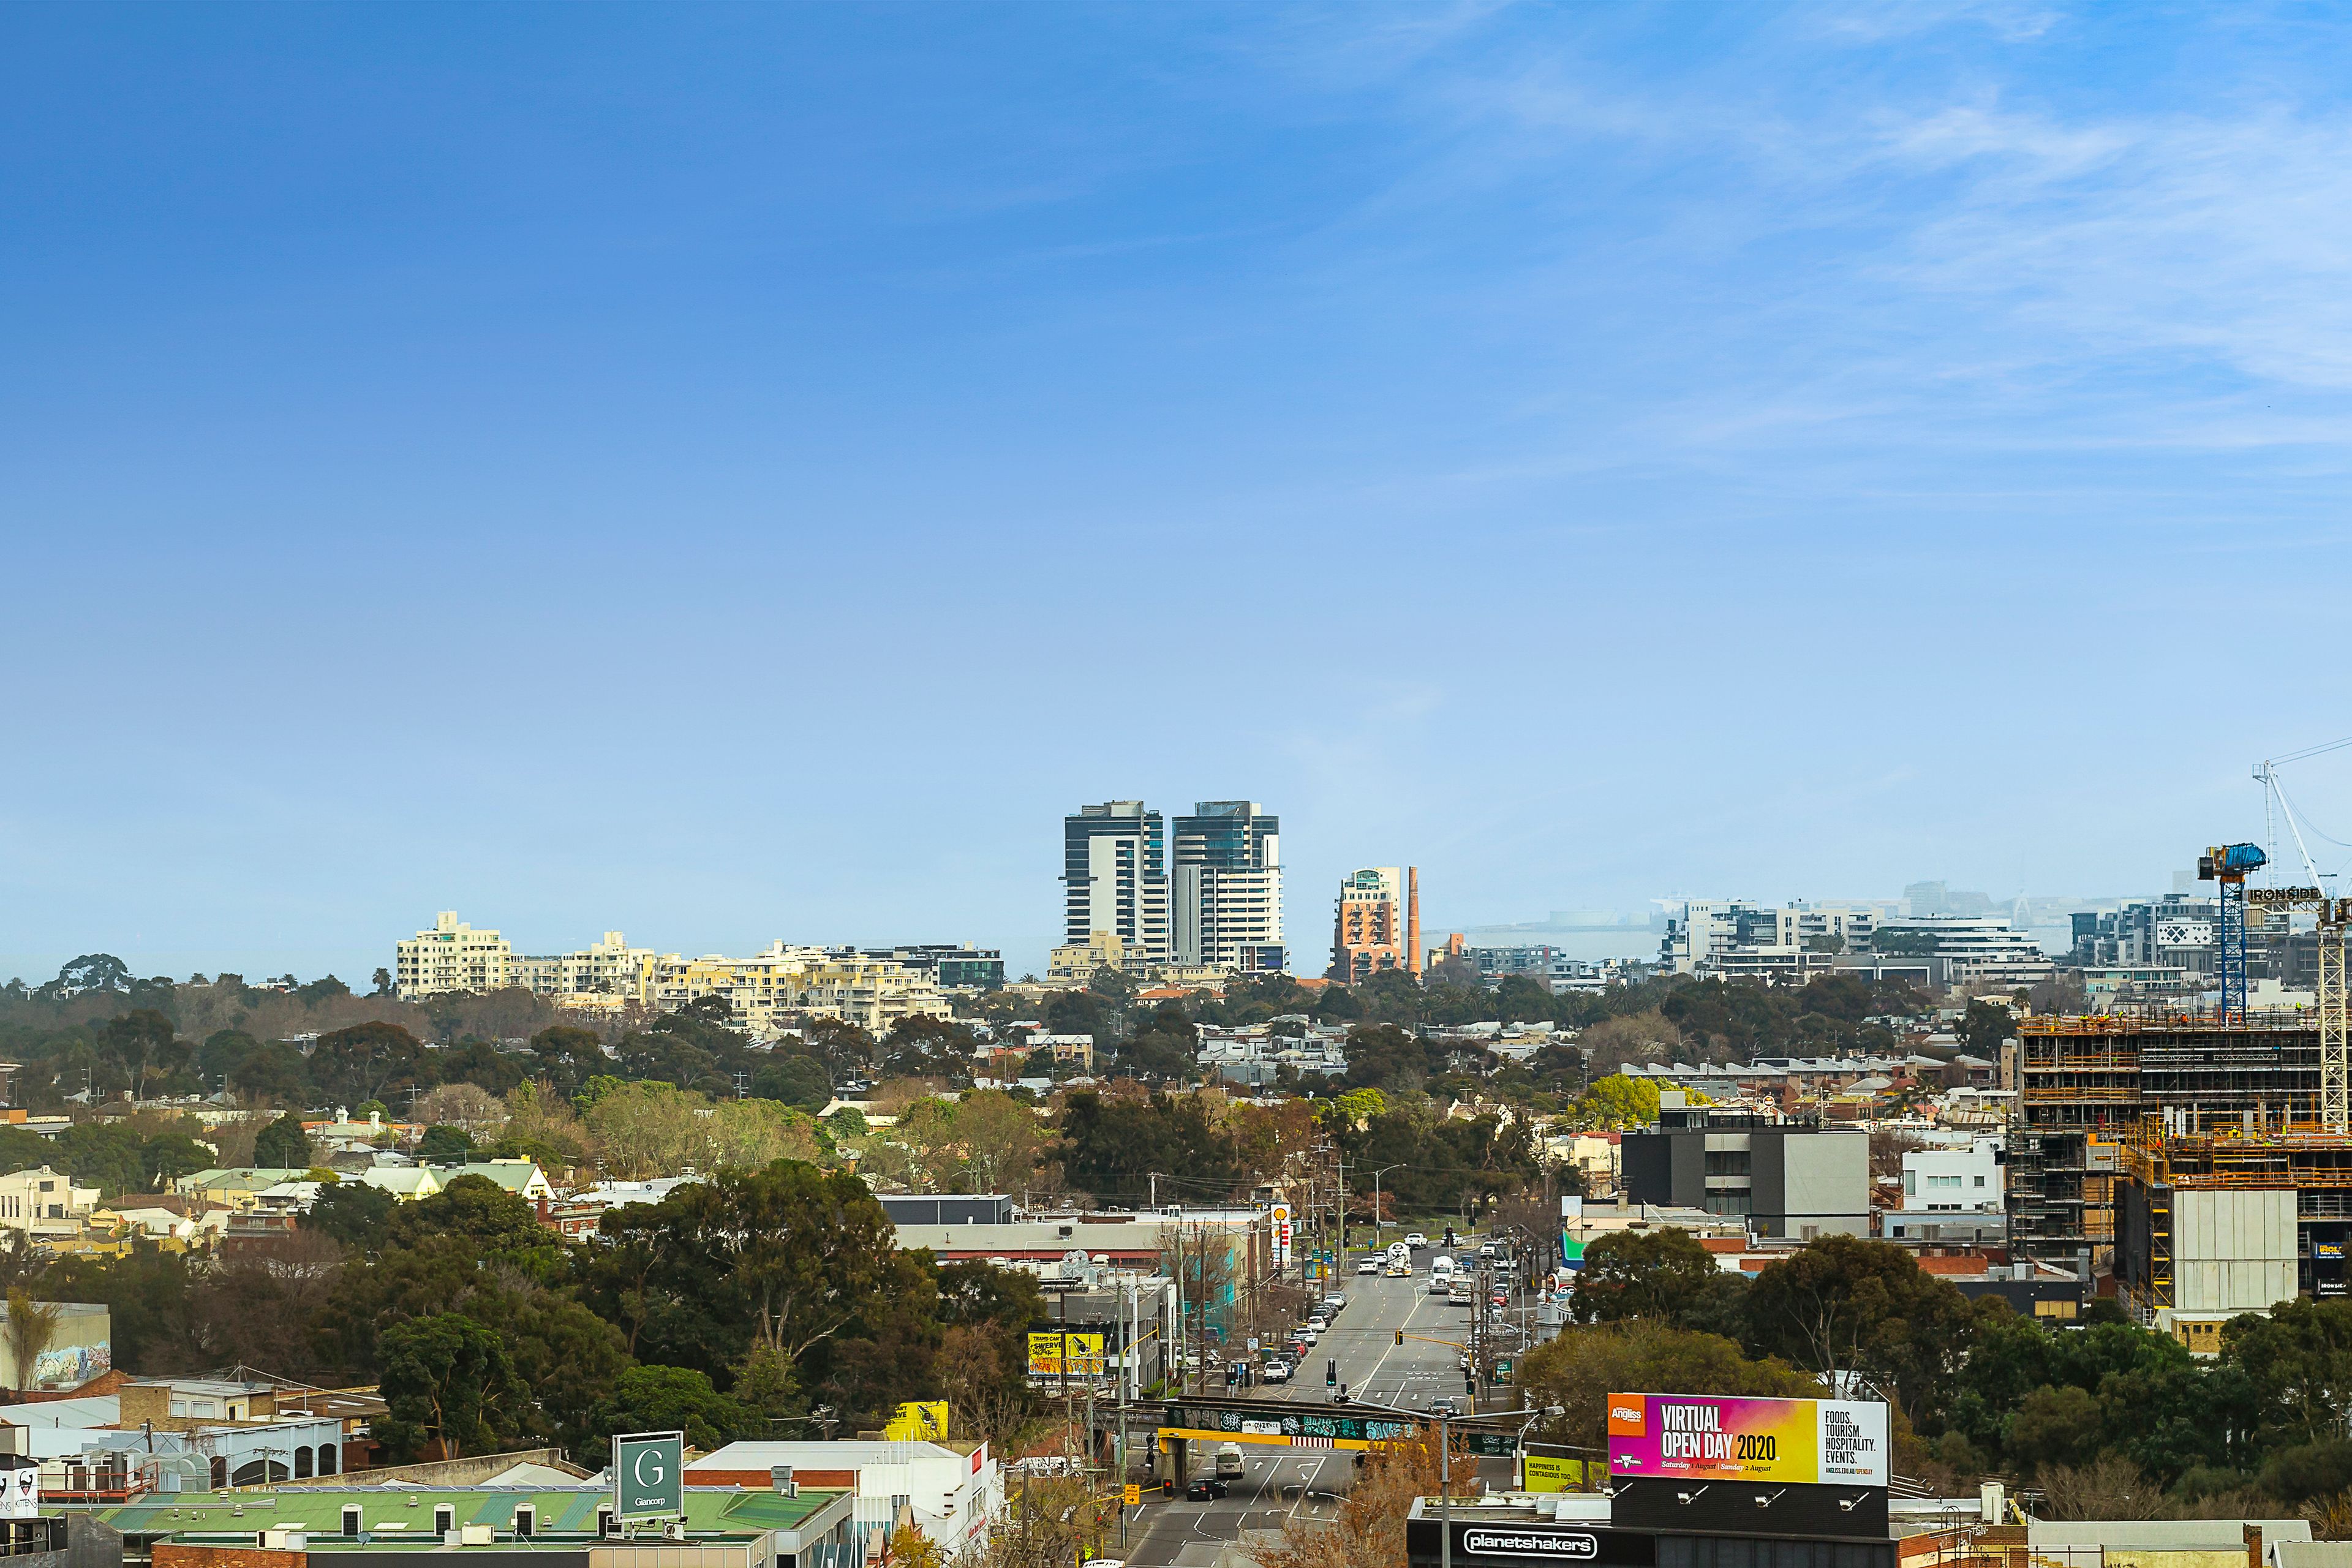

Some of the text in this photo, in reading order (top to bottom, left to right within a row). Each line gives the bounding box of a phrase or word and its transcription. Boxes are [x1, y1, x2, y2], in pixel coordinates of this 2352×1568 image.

[1611, 1408, 1642, 1421] Angliss
[1661, 1404, 1722, 1432] VIRTUAL
[1825, 1411, 1852, 1424] FOODS.
[1825, 1424, 1862, 1438] TOURISM.
[1661, 1431, 1781, 1461] OPEN DAY 2020.
[1825, 1437, 1876, 1452] HOSPITALITY.
[1825, 1450, 1857, 1464] EVENTS.
[635, 1448, 664, 1488] G
[1661, 1461, 1691, 1470] Saturday
[1721, 1463, 1744, 1472] Sunday
[1529, 1470, 1559, 1479] CONTAGIOUS
[15, 1498, 37, 1509] KITTENS
[635, 1498, 665, 1506] Giancorp
[1470, 1534, 1591, 1552] planetshakers
